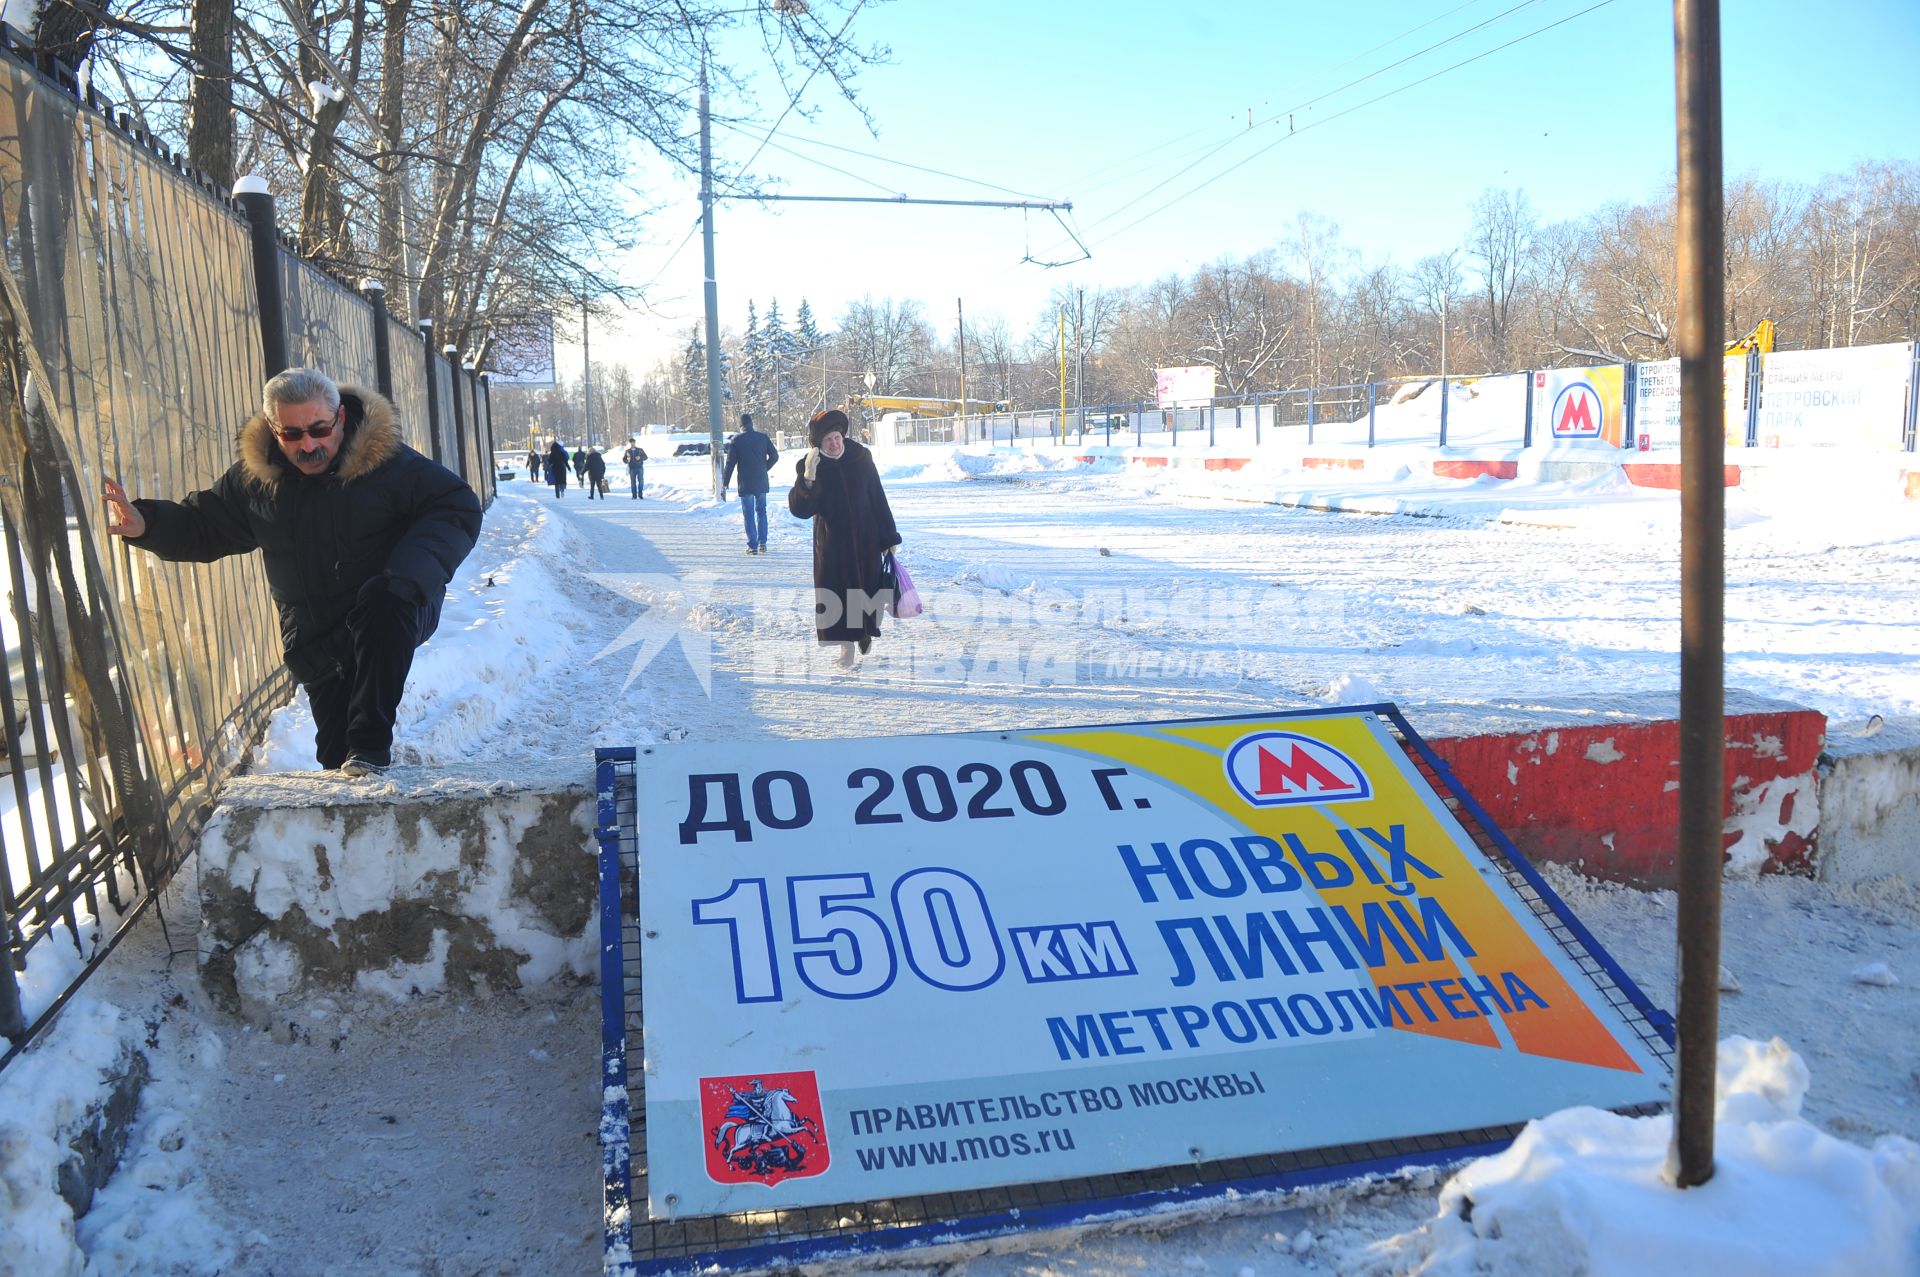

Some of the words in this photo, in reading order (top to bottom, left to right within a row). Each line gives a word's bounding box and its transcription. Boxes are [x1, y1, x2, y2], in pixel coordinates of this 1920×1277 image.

[1639, 387, 1680, 397] ПЕРЕСАДОЧ
[1640, 364, 1680, 375] СТРОИТЕЛЬ
[1640, 376, 1673, 387] ТРЕТЬЕГО
[1766, 412, 1802, 427] ПАРК
[678, 770, 814, 844] ДО
[847, 760, 1067, 825] 2020
[1091, 767, 1152, 812] г.
[1116, 824, 1444, 903] НОВЫХ
[691, 866, 1006, 1004] 150
[1157, 882, 1478, 988] ЛИНИЙ
[1046, 971, 1550, 1062] МЕТРОПОЛИТЕНА
[849, 1086, 1123, 1136] ПРАВИТЕЛЬСТВО
[1132, 1071, 1266, 1108] МОСКВЫ
[856, 1126, 1076, 1172] www.mos.ru
